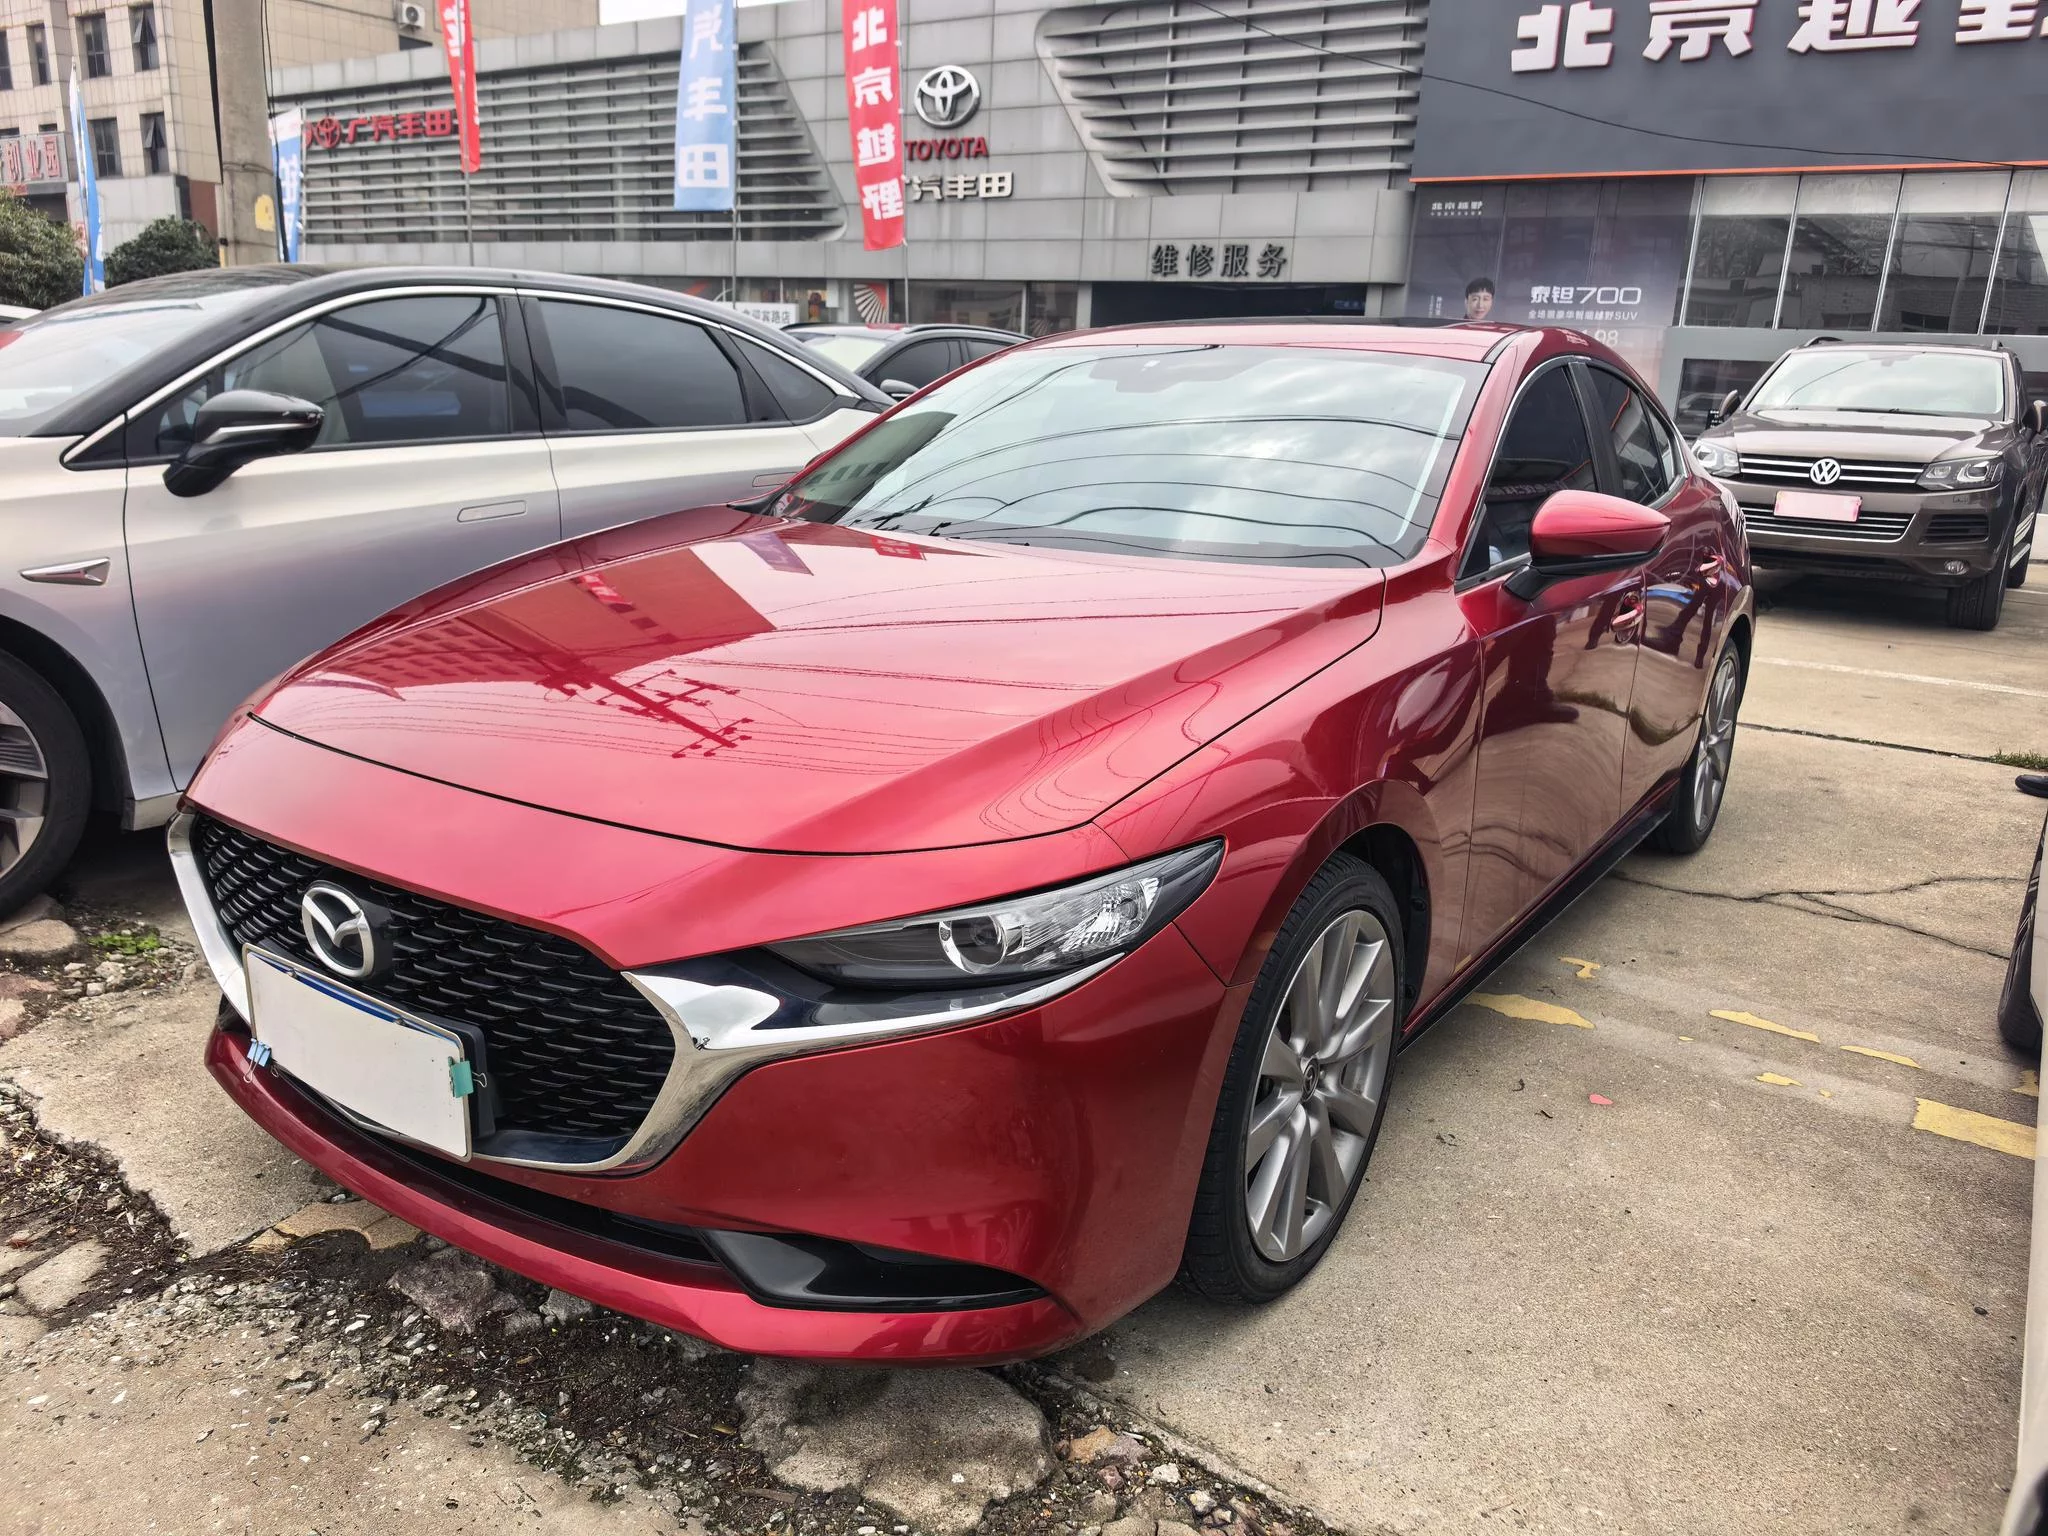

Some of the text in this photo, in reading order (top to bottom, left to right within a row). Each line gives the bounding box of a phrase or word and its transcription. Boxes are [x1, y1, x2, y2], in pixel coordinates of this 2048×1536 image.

[345, 110, 452, 144] 广汽丰田
[0, 135, 61, 183] 创业园
[904, 137, 989, 161] TOYOTA
[904, 171, 1013, 200] 汽丰田
[1151, 243, 1287, 278] 维修服务
